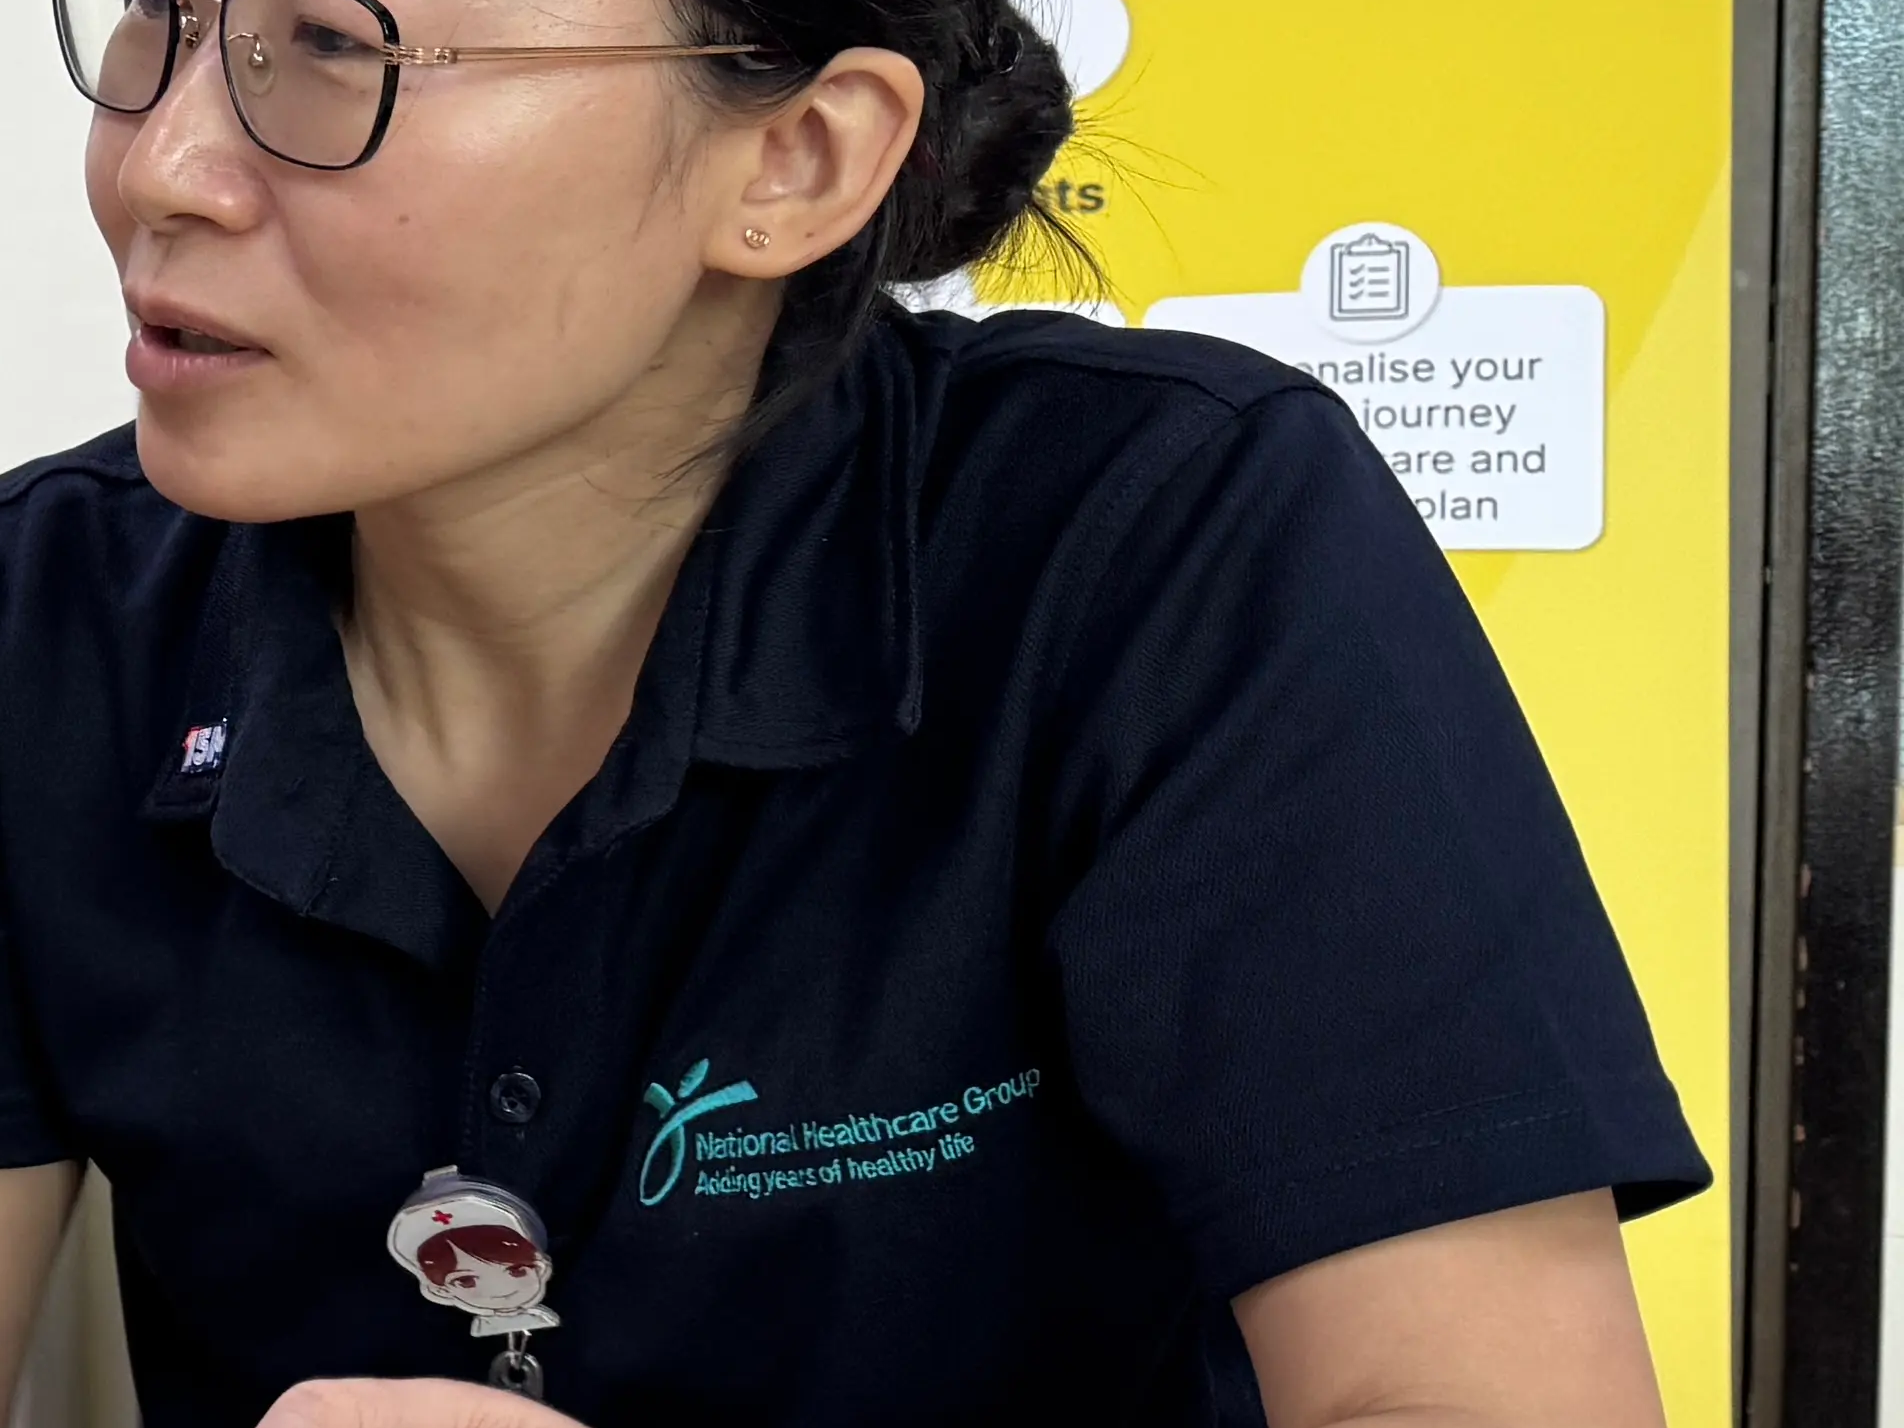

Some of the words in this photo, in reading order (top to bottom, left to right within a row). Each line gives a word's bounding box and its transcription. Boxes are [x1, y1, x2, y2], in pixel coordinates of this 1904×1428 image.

[1450, 357, 1542, 389] your
[1362, 398, 1516, 435] journey
[1381, 449, 1455, 474] are
[1470, 443, 1546, 473] and
[695, 1125, 799, 1162] National
[803, 1099, 960, 1152] Healthcare
[963, 1067, 1041, 1118] Group
[694, 1166, 761, 1200] Adding
[762, 1165, 816, 1197] years
[818, 1159, 842, 1184] of
[847, 1145, 937, 1181] healthy
[938, 1132, 975, 1163] life
